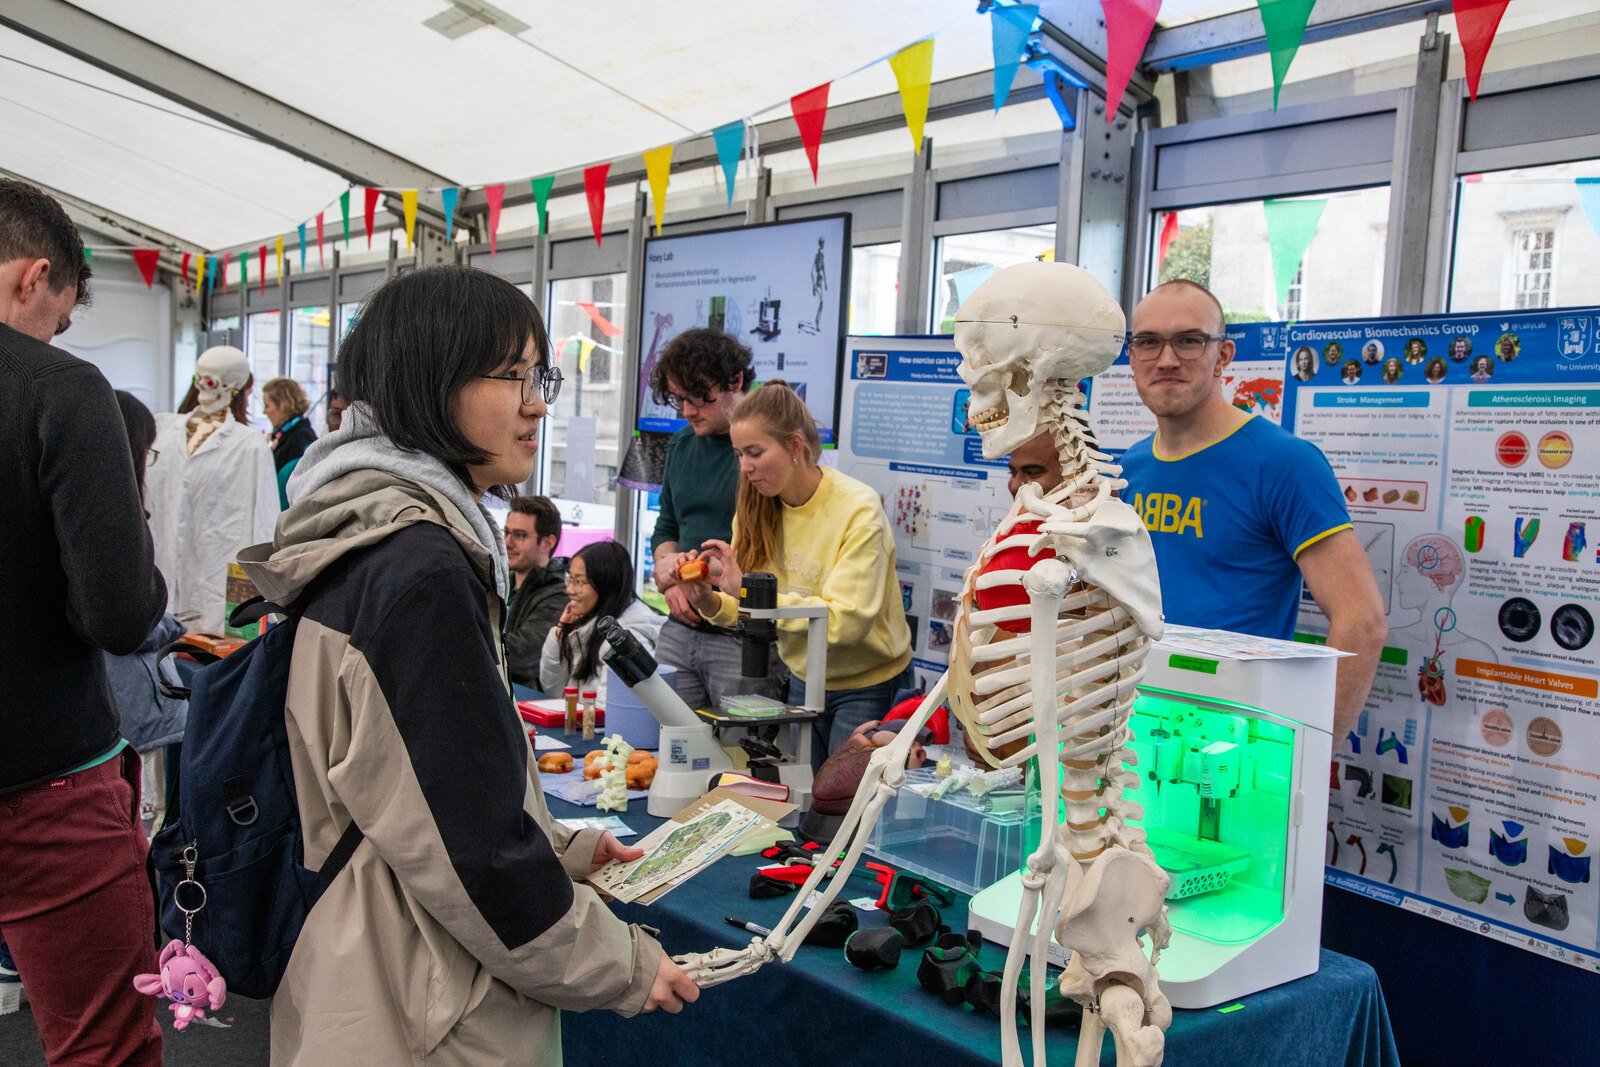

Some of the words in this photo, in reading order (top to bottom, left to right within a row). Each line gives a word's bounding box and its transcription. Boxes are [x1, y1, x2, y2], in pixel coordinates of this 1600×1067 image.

[664, 251, 673, 261] Lab
[1292, 329, 1362, 341] Cardiovascular
[1365, 325, 1439, 338] Biomechanics
[1442, 324, 1480, 336] Group
[1512, 322, 1546, 330] @LallyLab
[947, 357, 959, 366] help
[1469, 582, 1505, 591] atherosclerotic
[1547, 582, 1565, 590] plaque
[1571, 584, 1598, 592] analogues
[1530, 650, 1551, 658] Diseased
[1569, 656, 1594, 664] Analogues
[1477, 666, 1522, 680] Implantable
[1524, 674, 1545, 685] Heart
[1548, 677, 1574, 690] Valves
[1485, 699, 1508, 709] mortality.
[1515, 688, 1538, 698] stiffening
[1555, 695, 1582, 706] thickening
[1561, 704, 1576, 713] blood
[1578, 706, 1590, 715] flow
[1433, 738, 1451, 746] Current
[1452, 741, 1480, 753] commercial
[1482, 746, 1500, 757] devices
[1501, 752, 1516, 761] suffer
[1517, 755, 1530, 763] from
[1531, 759, 1544, 768] poor
[1545, 761, 1572, 774] durability,
[1445, 760, 1467, 772] benchtop
[1468, 766, 1485, 776] testing
[1497, 771, 1521, 784] modelling
[1522, 778, 1553, 790] techniques,
[1574, 790, 1596, 801] working
[1462, 780, 1495, 794] longer-lasting
[1496, 788, 1517, 798] devices.
[1516, 785, 1529, 794] used
[1542, 790, 1572, 804] developing
[1437, 786, 1469, 799] Computational
[1470, 793, 1484, 802] Model
[1496, 799, 1516, 810] Different
[1517, 805, 1543, 818] Underlying
[1544, 811, 1556, 820] Fibre
[1557, 815, 1585, 827] Alignments
[1455, 856, 1469, 865] Native
[1470, 860, 1483, 869] Tissue
[1506, 870, 1532, 883] Bioinspired
[1533, 878, 1553, 889] Polymer
[1554, 884, 1573, 894] Devices
[1336, 876, 1366, 892] Biomedical
[1366, 885, 1400, 904] Engineering
[1536, 940, 1549, 950] RCSI
